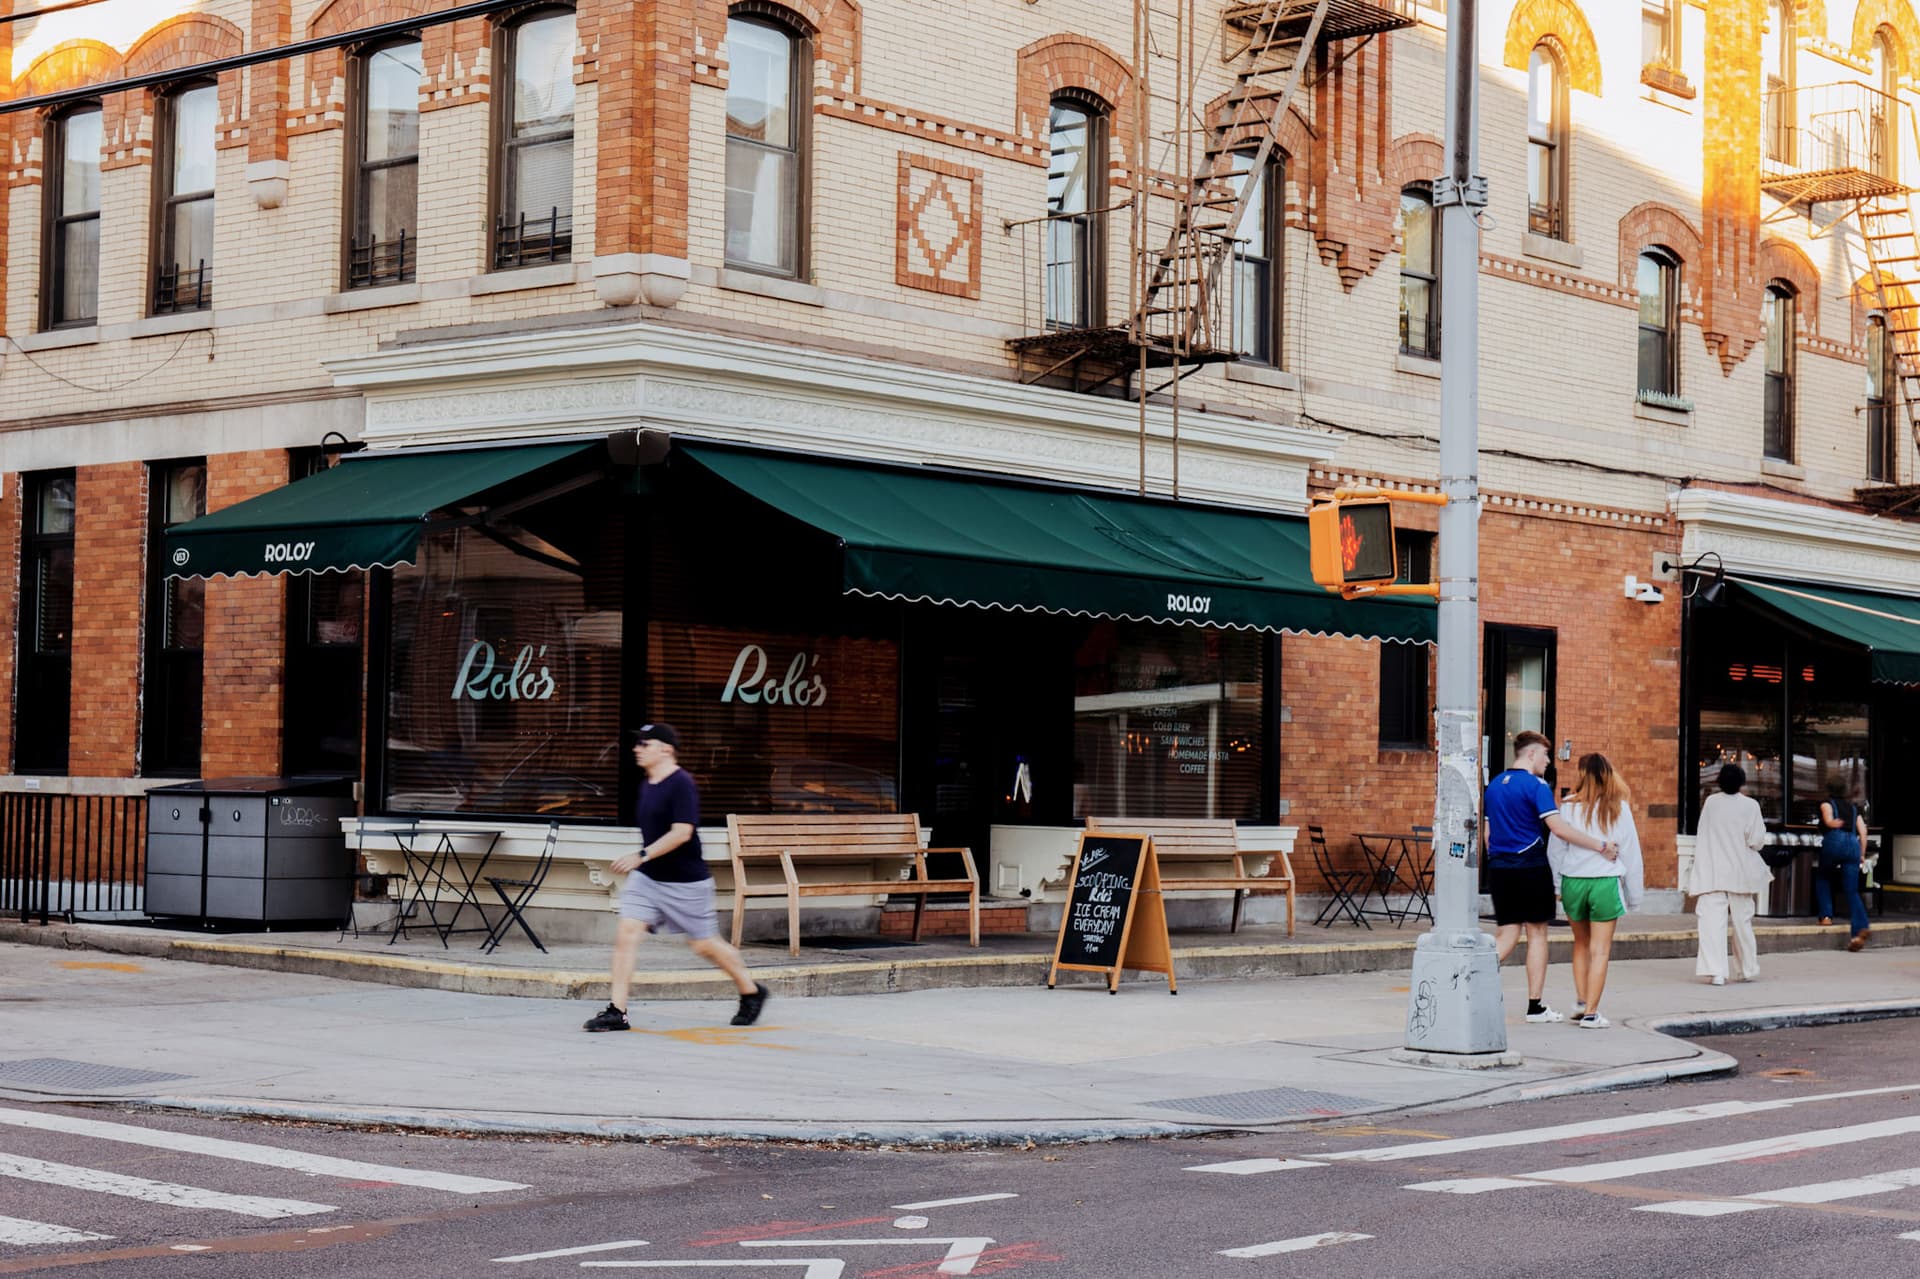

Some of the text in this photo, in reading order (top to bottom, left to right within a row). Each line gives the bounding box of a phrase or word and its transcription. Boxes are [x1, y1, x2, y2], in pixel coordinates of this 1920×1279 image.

[451, 641, 555, 700] Rolo's
[720, 644, 827, 706] Rolo's
[1152, 721, 1172, 732] COLD
[1168, 750, 1230, 760] HOMEMADE PASTA
[1180, 764, 1206, 774] COFFEE
[1079, 872, 1128, 888] SCOOPING
[1074, 903, 1120, 919] ICE CREAM
[1074, 918, 1116, 936] EVERYDAY!
